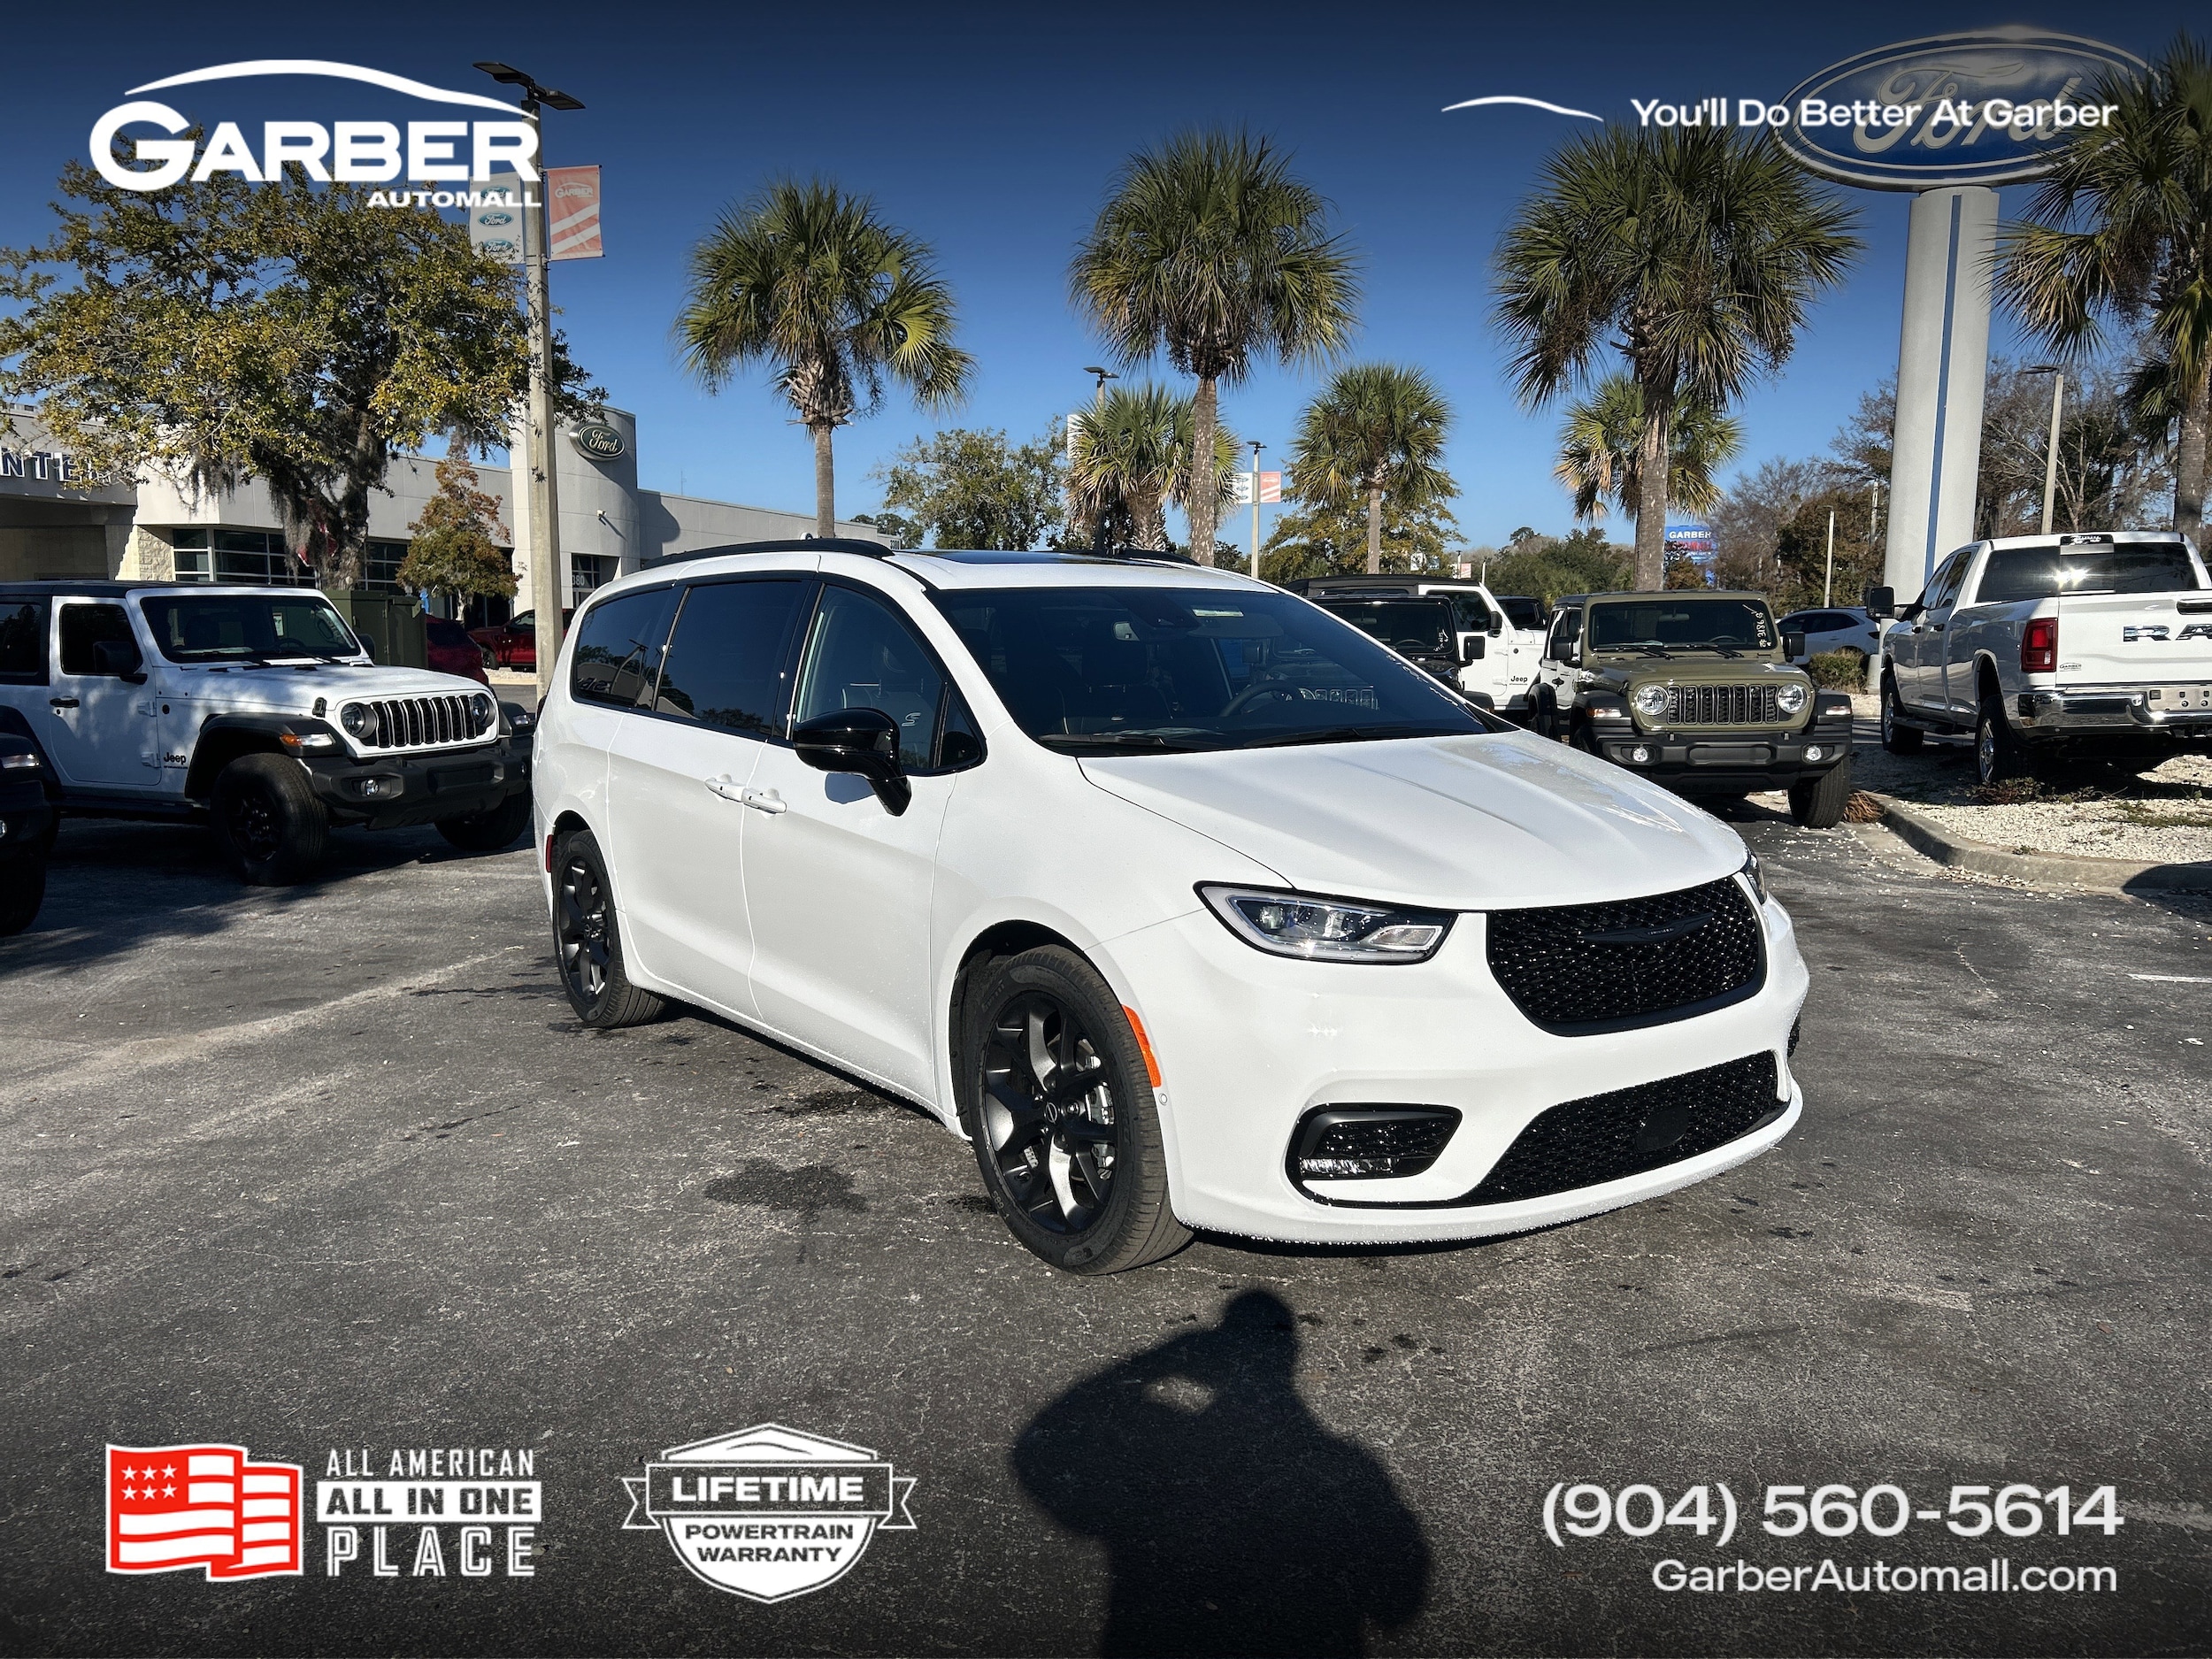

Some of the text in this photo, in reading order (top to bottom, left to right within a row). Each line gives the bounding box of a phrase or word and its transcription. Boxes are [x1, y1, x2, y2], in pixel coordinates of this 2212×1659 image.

[484, 212, 507, 226] Ford
[589, 429, 618, 452] Ford
[164, 752, 187, 764] Jeep
